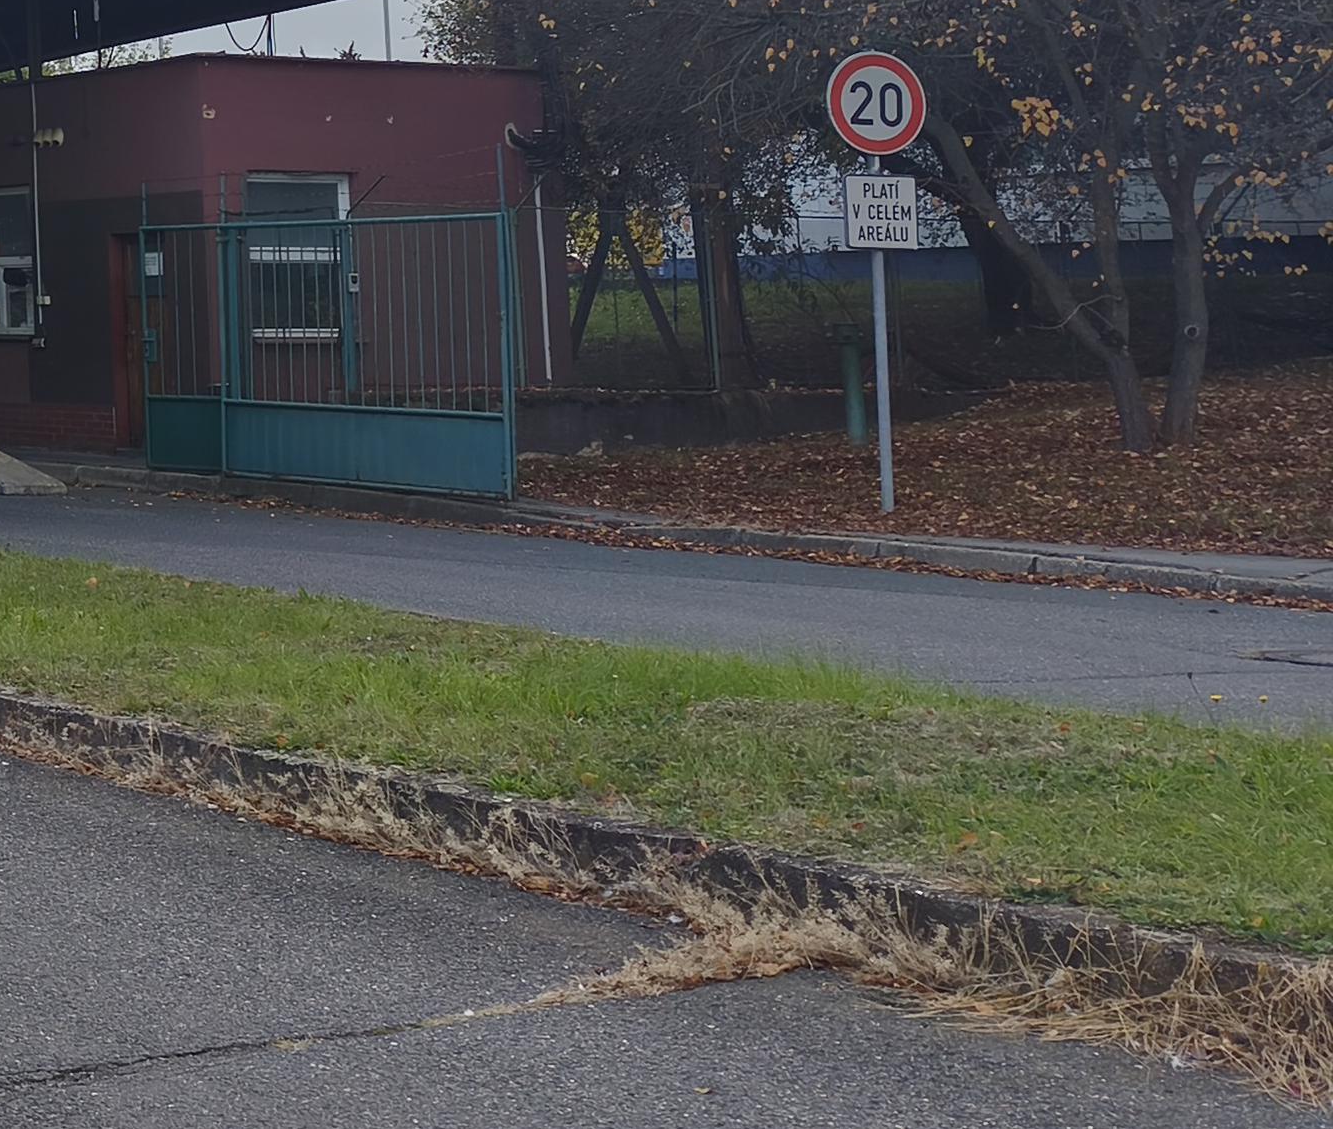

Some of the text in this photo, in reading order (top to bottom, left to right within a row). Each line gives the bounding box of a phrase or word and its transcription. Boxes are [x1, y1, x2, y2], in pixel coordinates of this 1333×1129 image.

[850, 81, 903, 127] 20
[863, 180, 900, 199] PLATÍ
[853, 202, 912, 221] V CELÉM
[858, 226, 909, 243] AREÁLU
